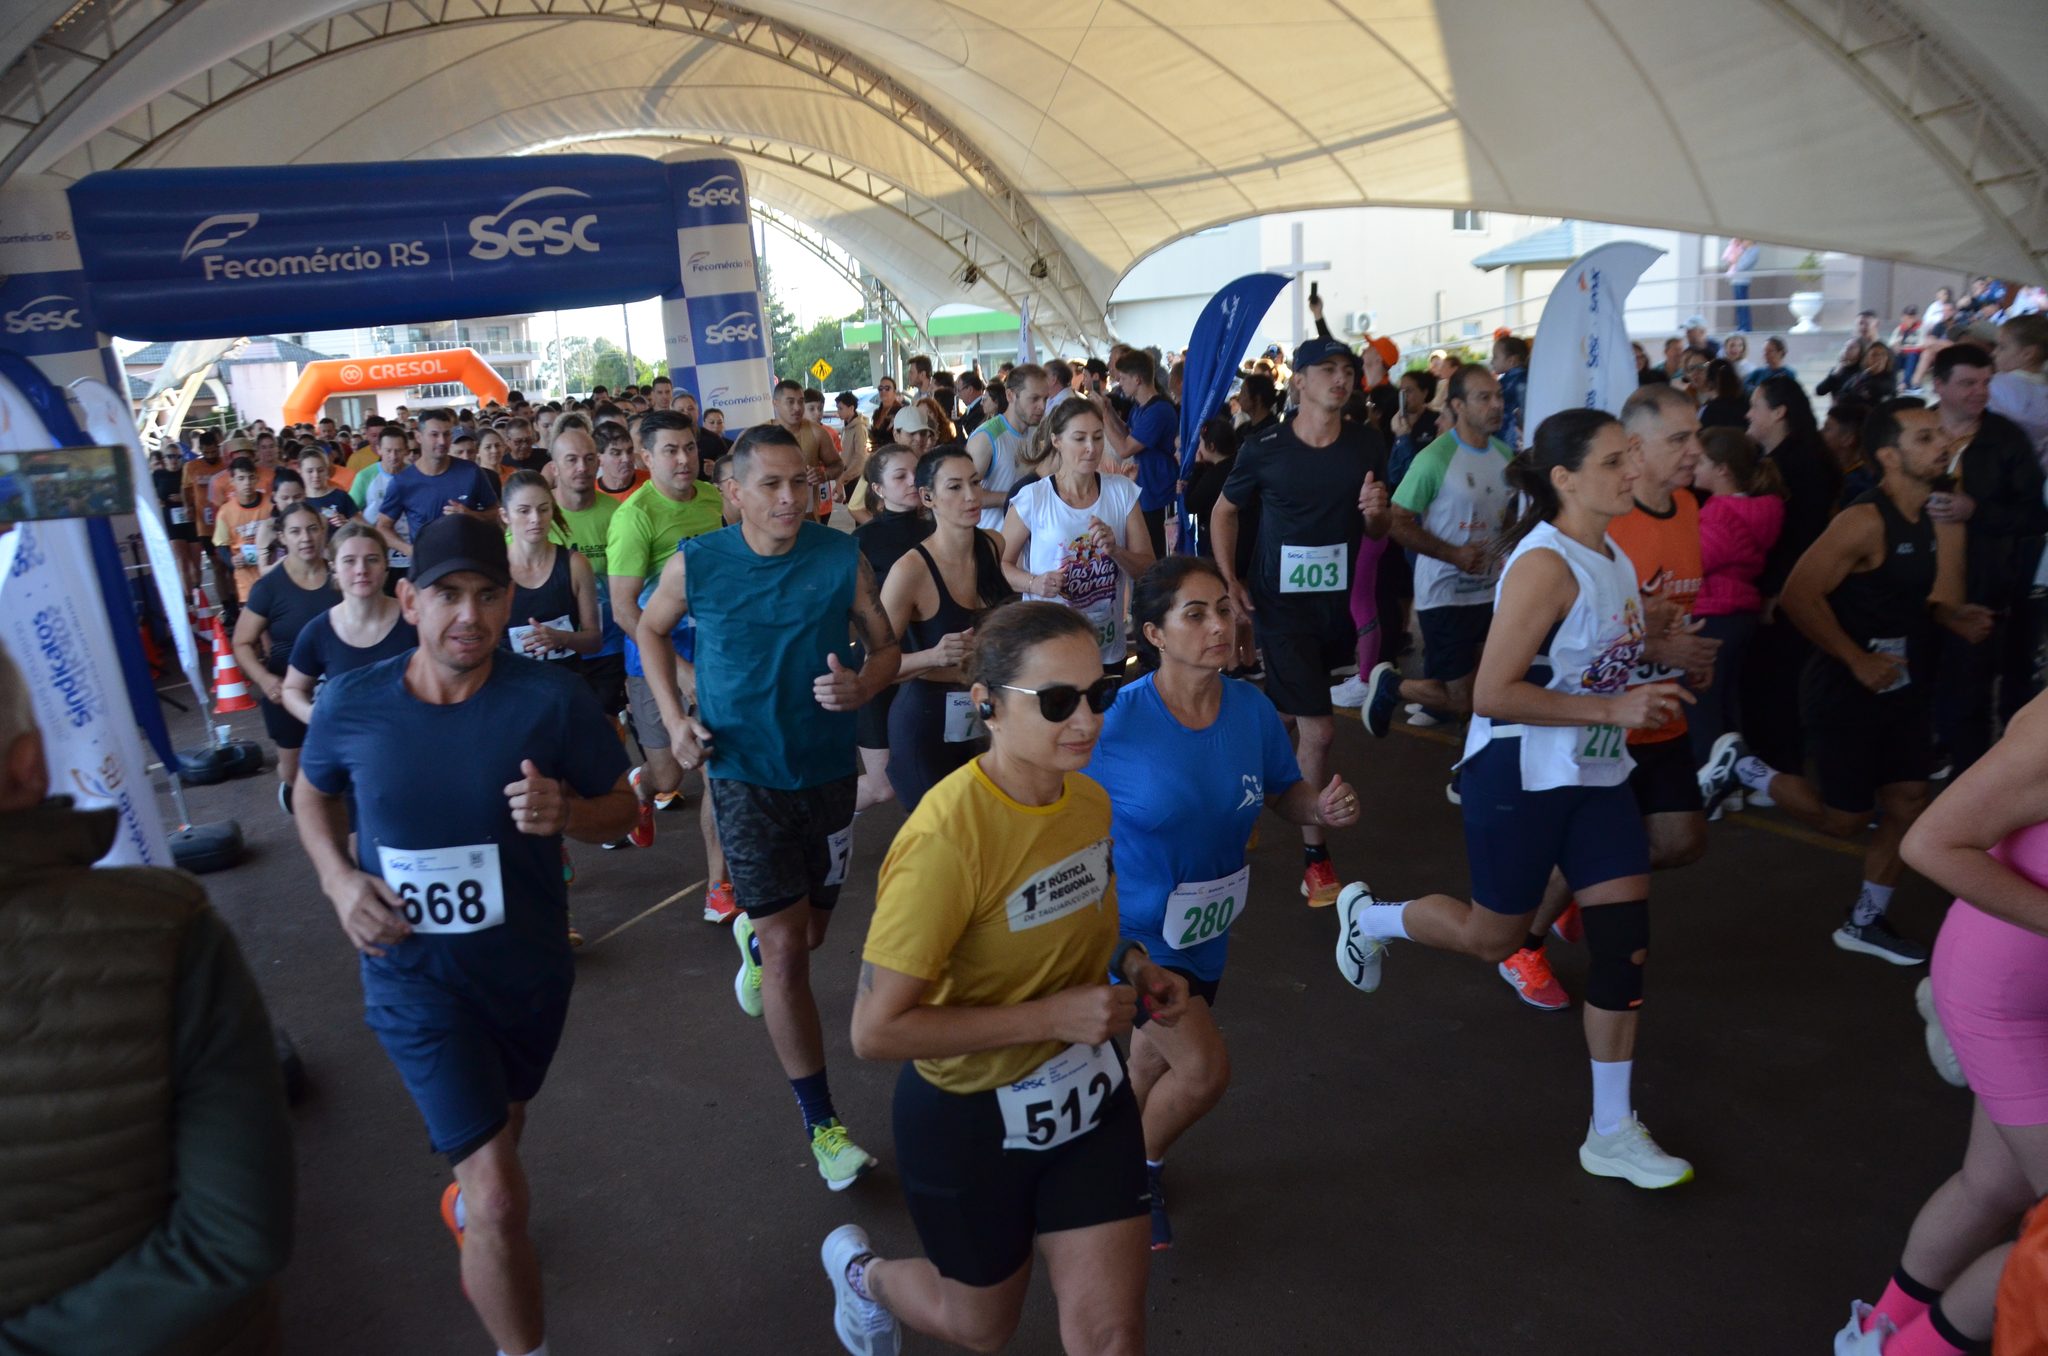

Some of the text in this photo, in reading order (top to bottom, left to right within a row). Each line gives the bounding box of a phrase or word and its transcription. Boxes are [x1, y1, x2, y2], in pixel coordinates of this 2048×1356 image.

[467, 203, 600, 260] Sesc
[203, 240, 430, 281] Fecomércio RS
[692, 260, 743, 273] Fecomércio
[6, 303, 83, 334] Sesc
[705, 319, 759, 345] Sesc
[369, 359, 448, 380] CRESOL
[1289, 562, 1339, 588] 403
[1048, 861, 1088, 889] RÚSTICA
[1050, 872, 1096, 901] REGIONAL
[398, 879, 487, 925] 668
[1179, 895, 1235, 945] 280
[1010, 1076, 1047, 1093] Sesc
[1025, 1071, 1112, 1146] 512
